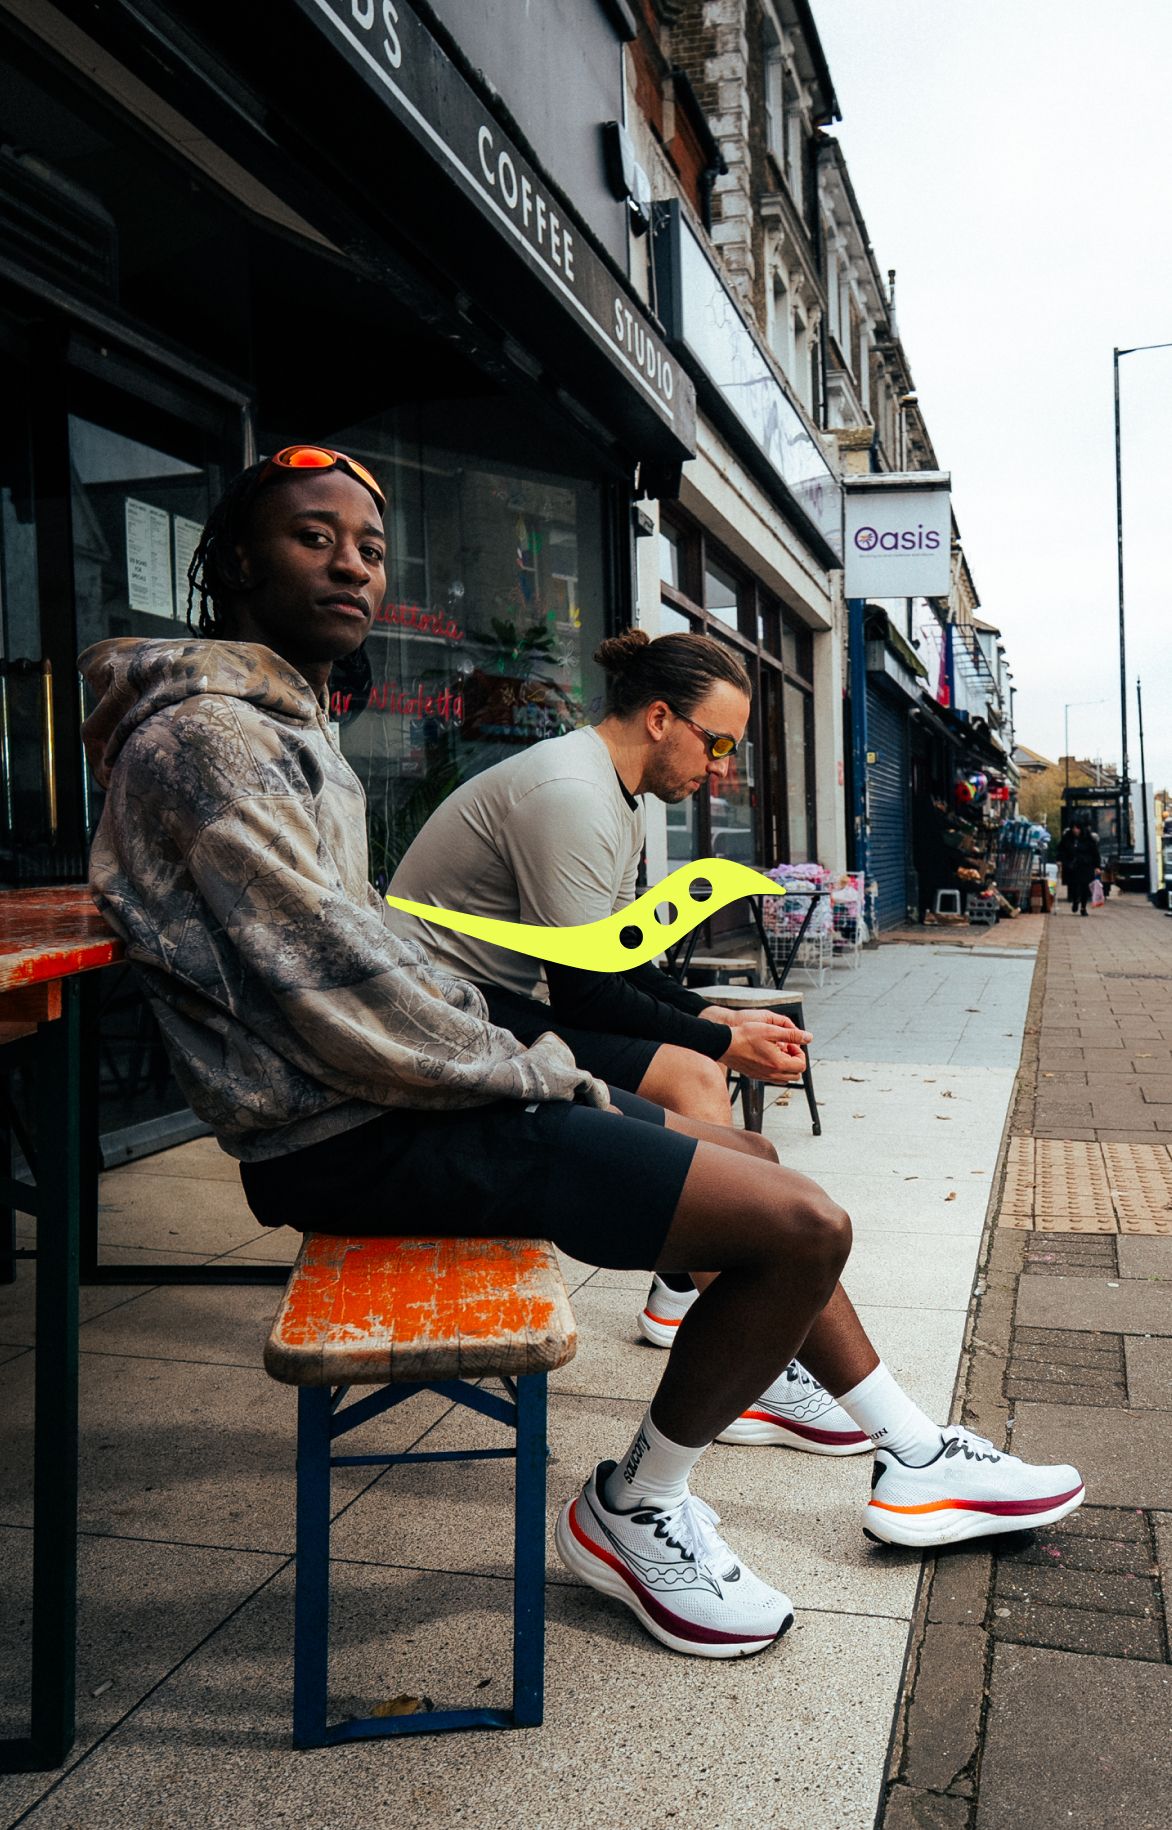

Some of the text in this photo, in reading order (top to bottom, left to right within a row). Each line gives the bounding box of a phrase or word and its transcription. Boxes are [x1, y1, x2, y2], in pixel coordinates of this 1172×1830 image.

[477, 125, 575, 282] COFFEE
[613, 298, 673, 400] STUDIO
[854, 524, 940, 551] Oasis
